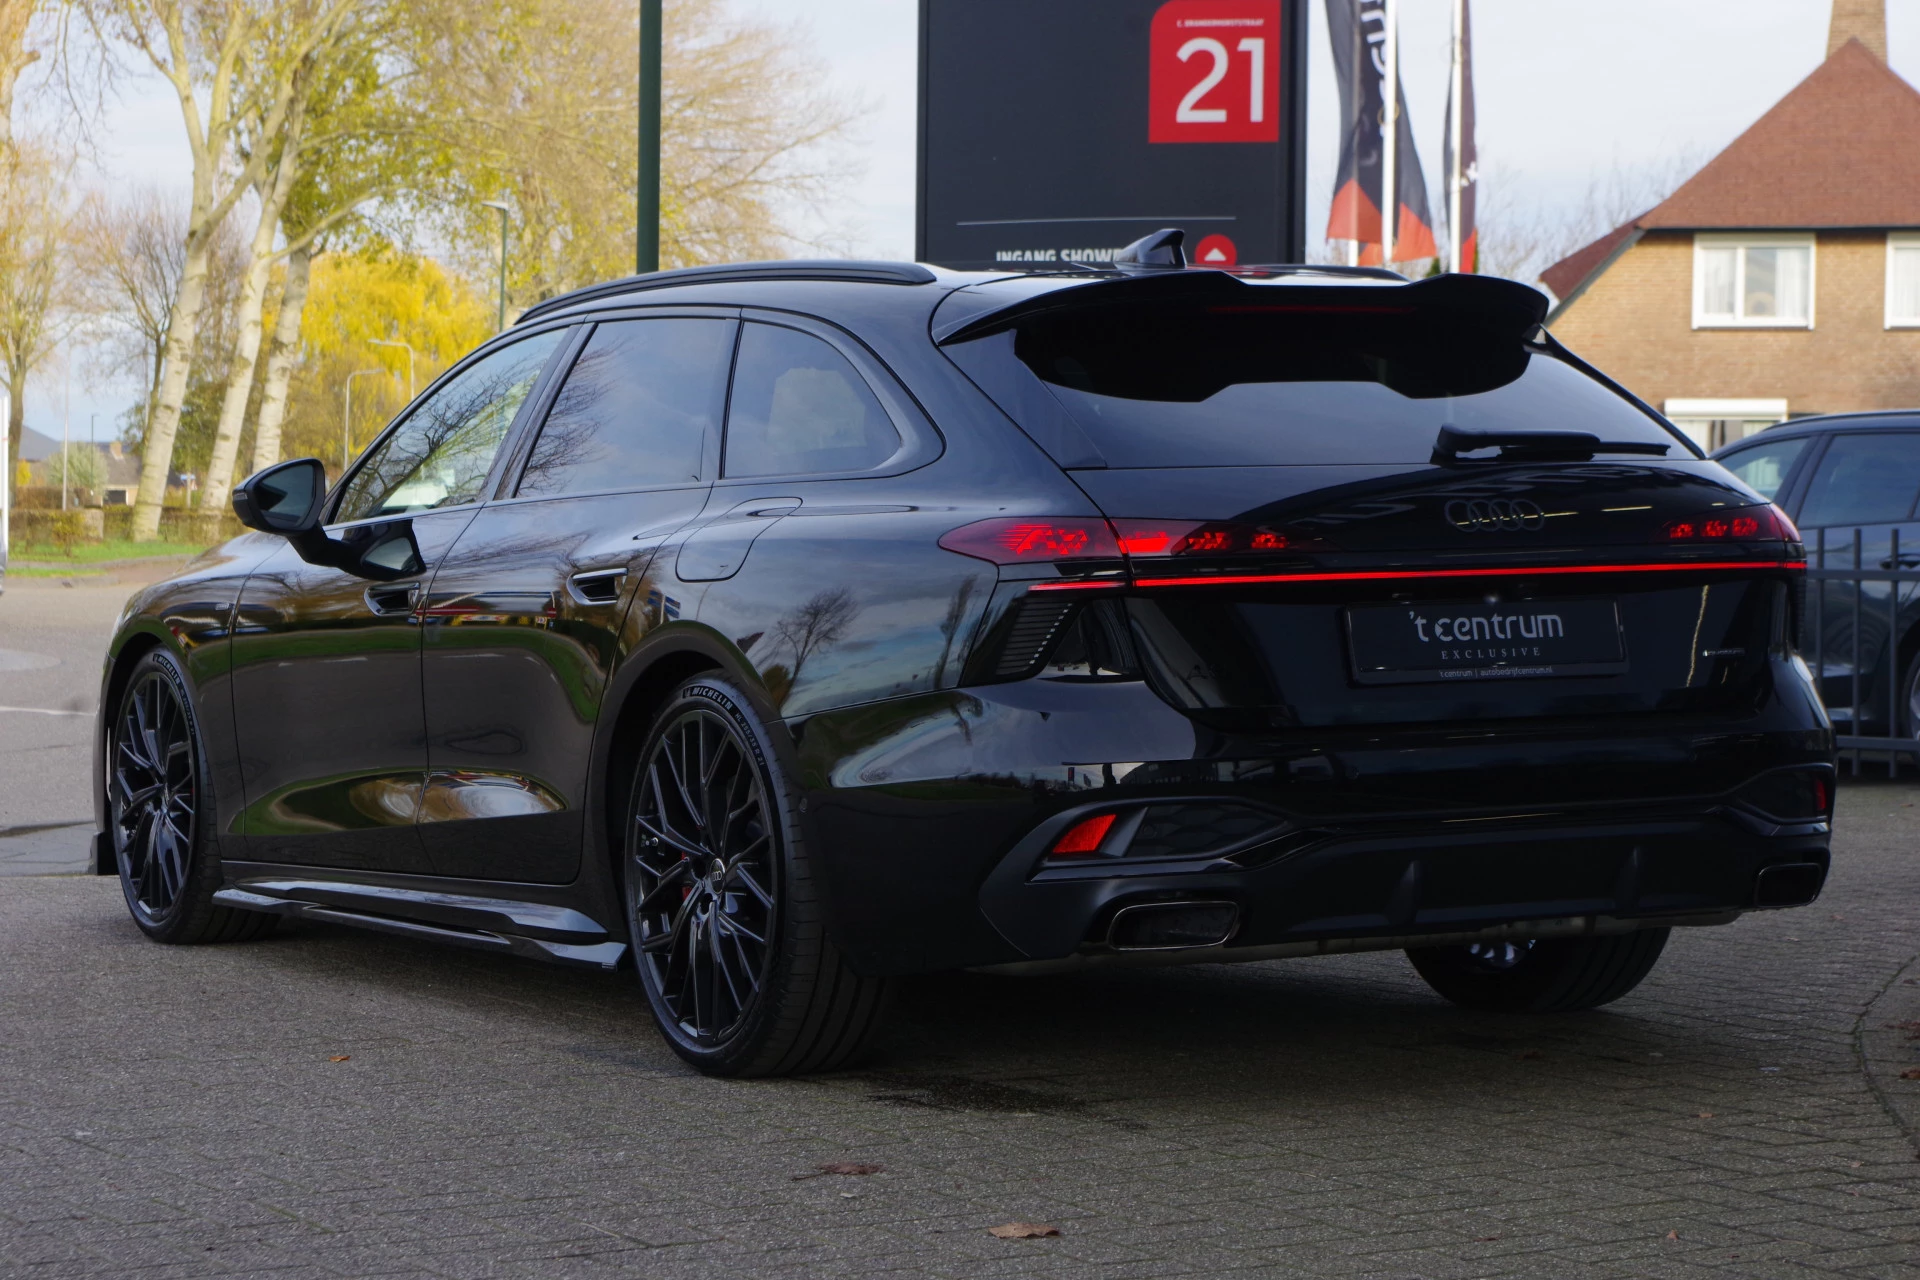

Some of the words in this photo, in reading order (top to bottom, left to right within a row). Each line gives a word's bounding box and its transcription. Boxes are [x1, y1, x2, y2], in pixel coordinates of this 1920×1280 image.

[1176, 37, 1264, 123] 21
[996, 249, 1057, 262] INGANG
[1434, 613, 1564, 642] centrum
[1441, 647, 1541, 660] EXCLUSIVE
[1444, 669, 1473, 678] centrum
[692, 686, 734, 711] MICHELIN
